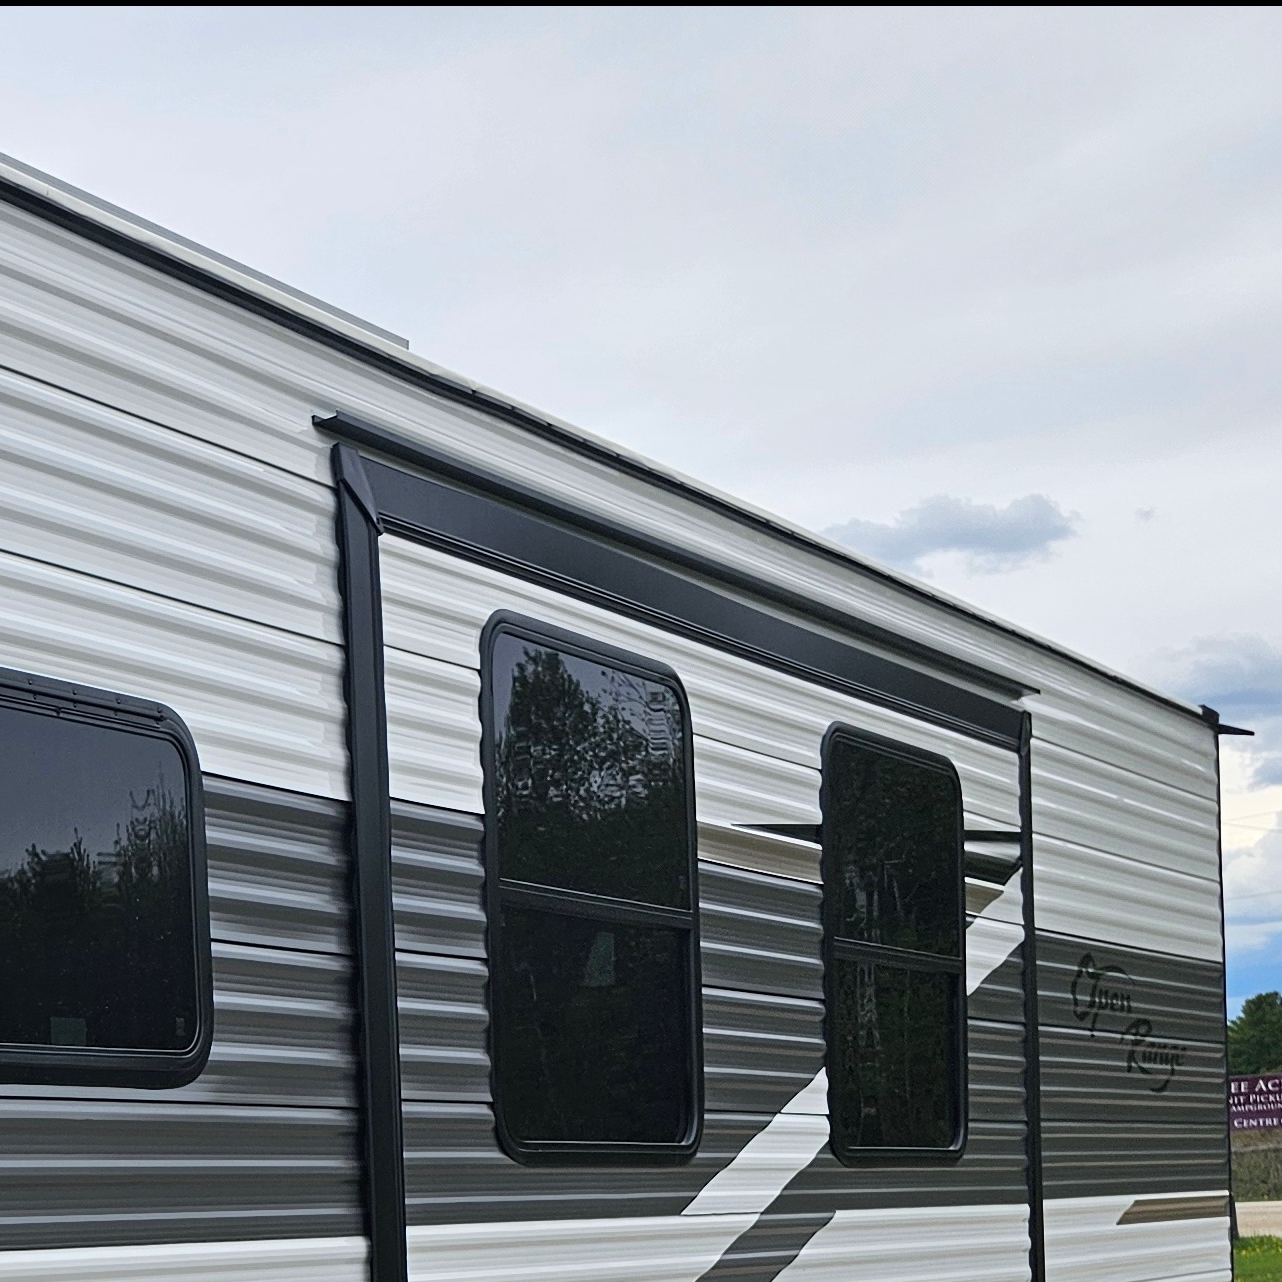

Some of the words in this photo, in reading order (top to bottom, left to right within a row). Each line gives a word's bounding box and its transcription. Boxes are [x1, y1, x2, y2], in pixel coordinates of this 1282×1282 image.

[1071, 952, 1135, 1037] Open
[1230, 1081, 1248, 1093] EE
[1255, 1079, 1282, 1092] AC
[1249, 1093, 1282, 1103] PICKU
[1234, 1117, 1278, 1128] CENTRE
